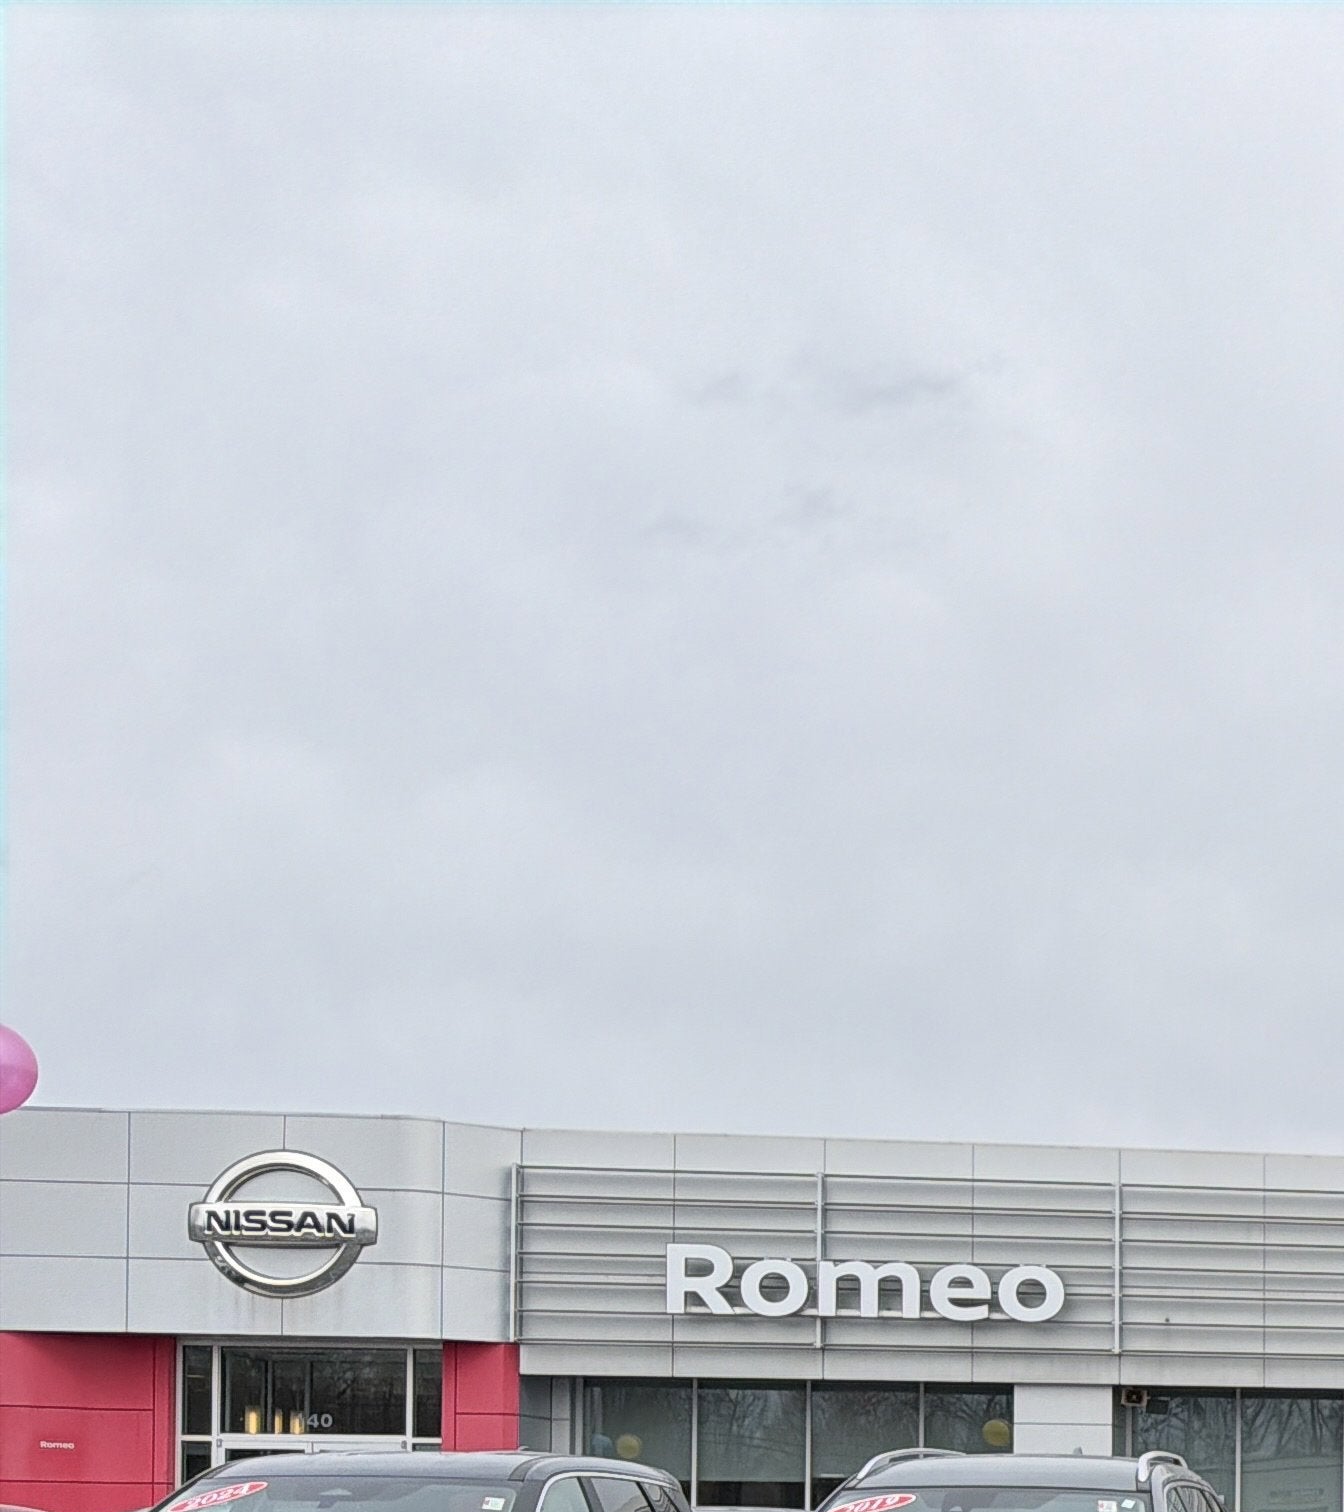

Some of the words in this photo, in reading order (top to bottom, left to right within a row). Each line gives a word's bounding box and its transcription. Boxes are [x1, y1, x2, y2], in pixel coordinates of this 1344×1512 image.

[204, 1210, 356, 1237] NISSAN
[667, 1243, 1064, 1322] Romeo
[40, 1440, 75, 1449] Romeo
[187, 1483, 250, 1508] 2024
